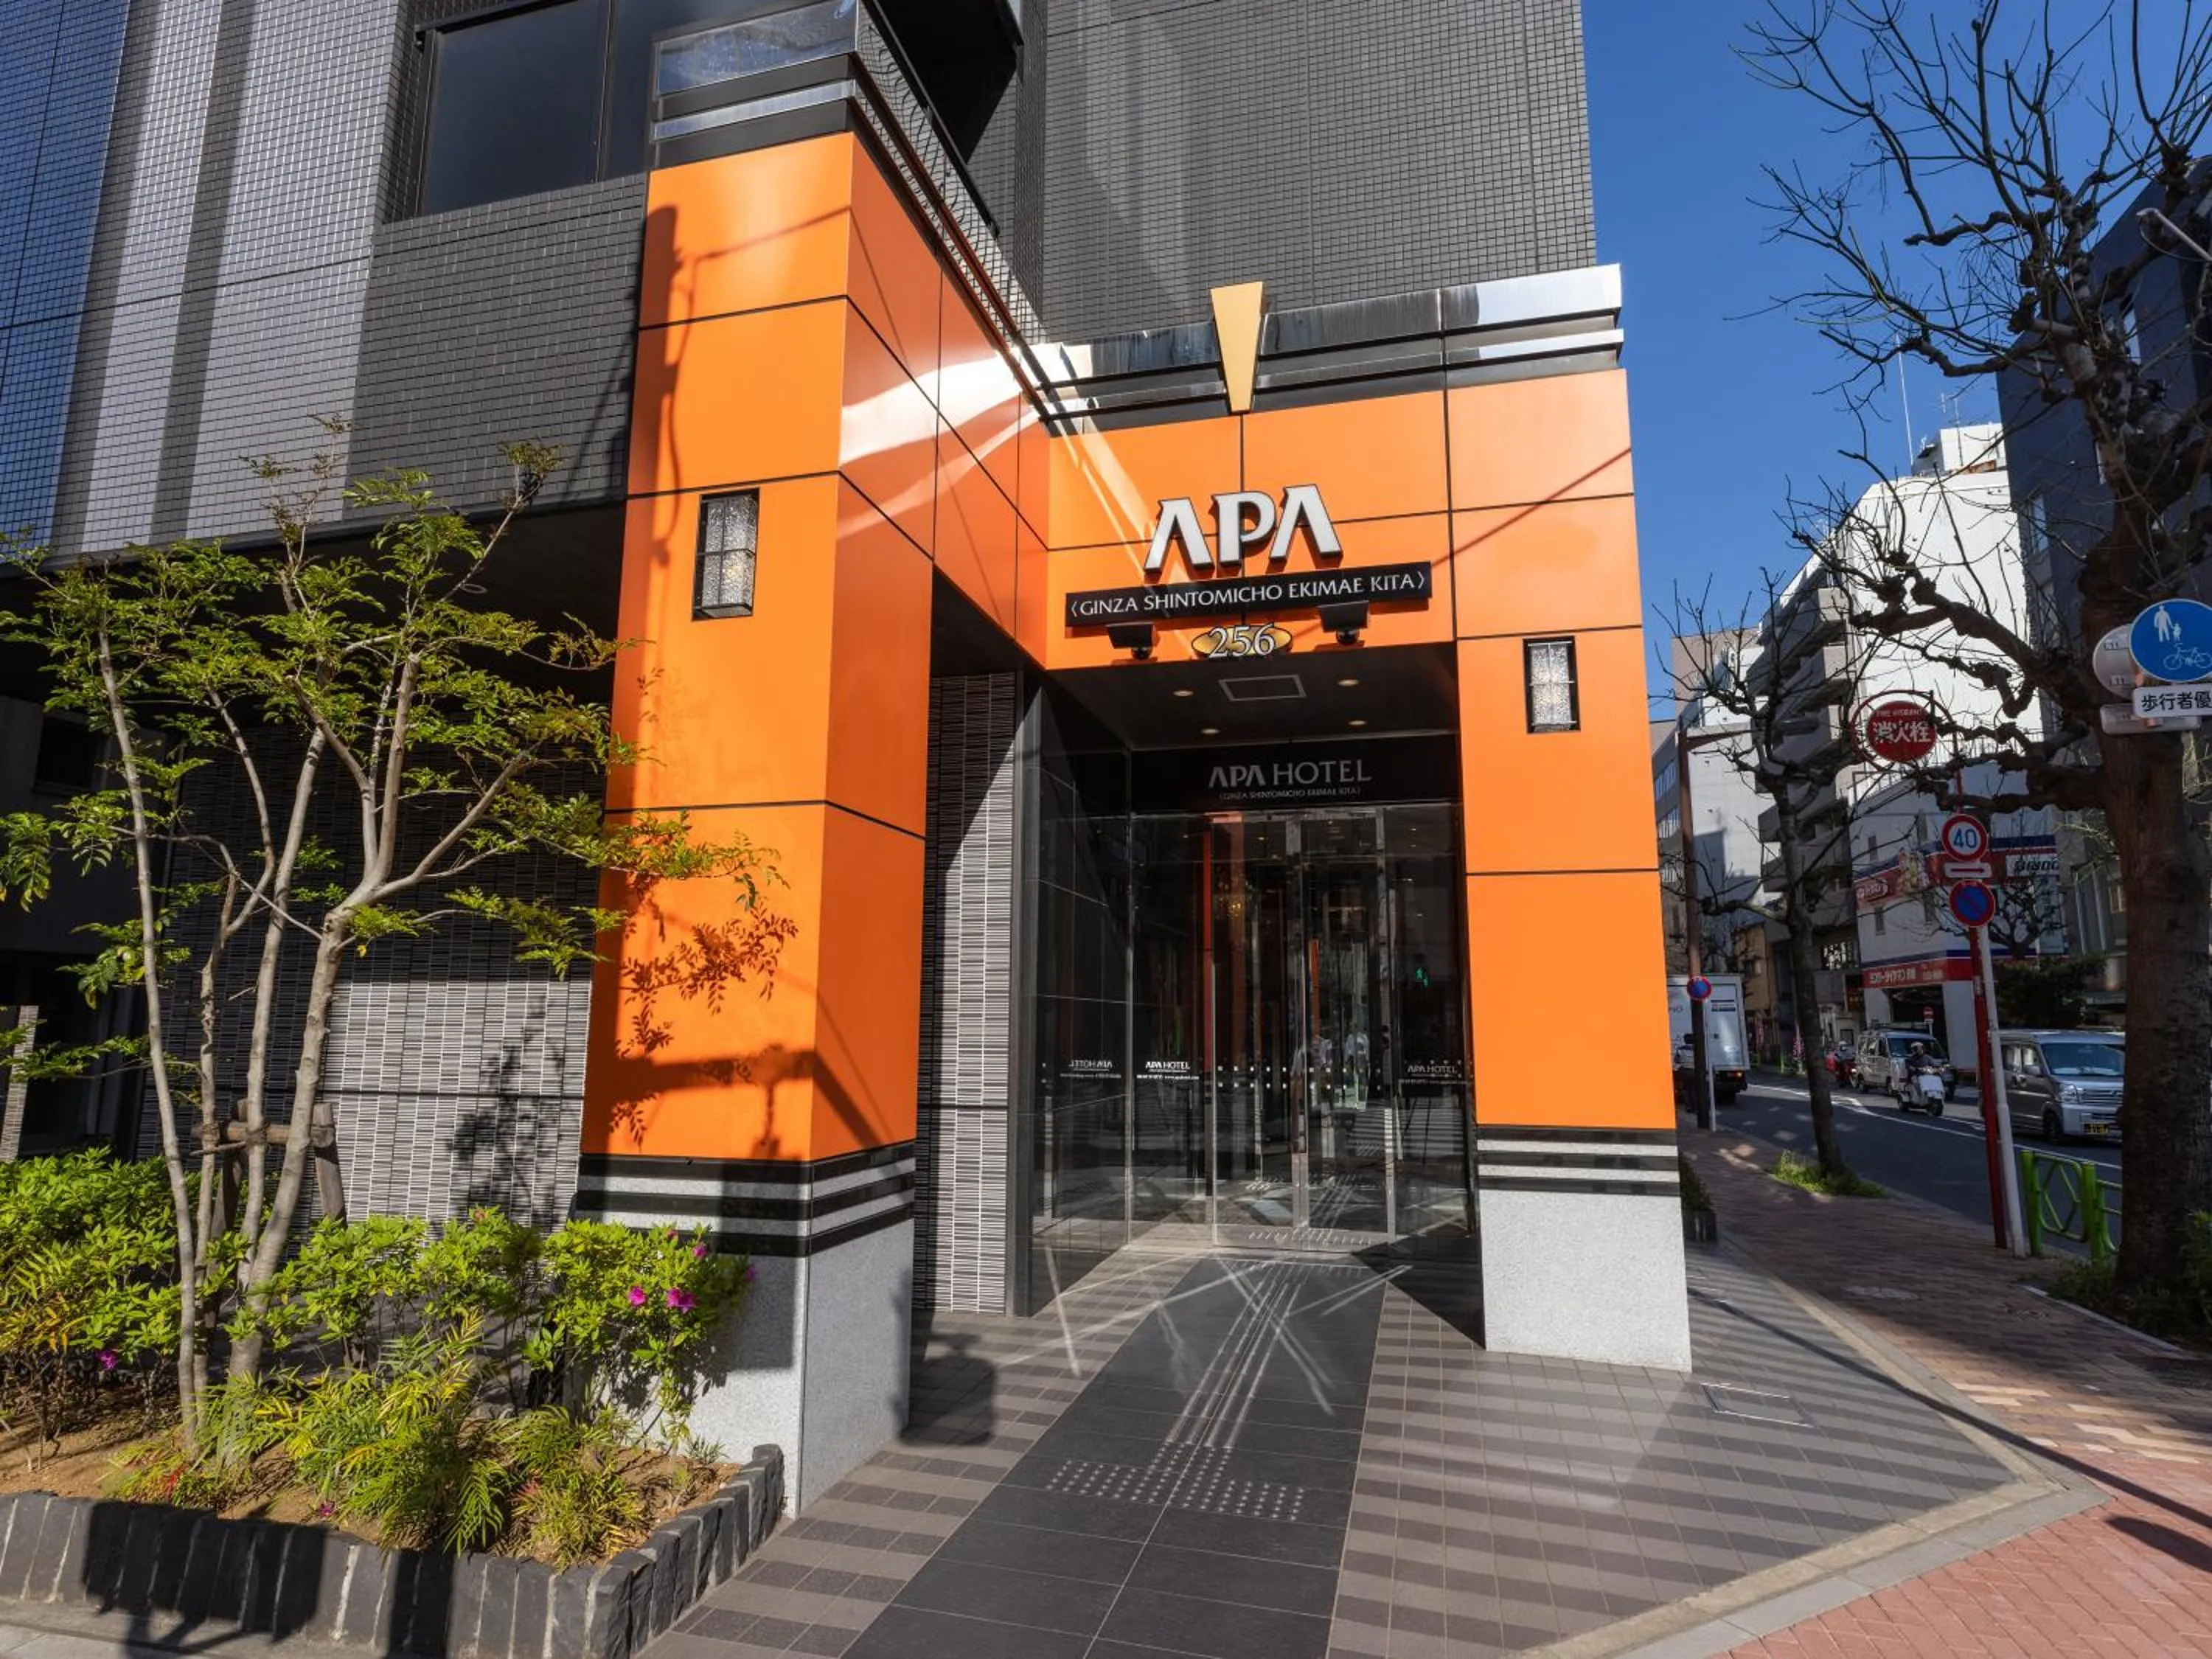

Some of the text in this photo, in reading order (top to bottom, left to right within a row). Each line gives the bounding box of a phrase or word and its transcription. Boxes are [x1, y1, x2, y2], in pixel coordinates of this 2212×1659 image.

[1144, 484, 1342, 571] APA
[1144, 585, 1282, 610] SHINTOMICHO
[1289, 578, 1363, 598] EKIMAE
[1209, 623, 1276, 657] 256
[1873, 720, 1931, 743] 消火栓
[1208, 759, 1372, 788] APA HOTEL
[1953, 828, 1977, 849] 40
[1145, 1061, 1191, 1069] APA HOTEL
